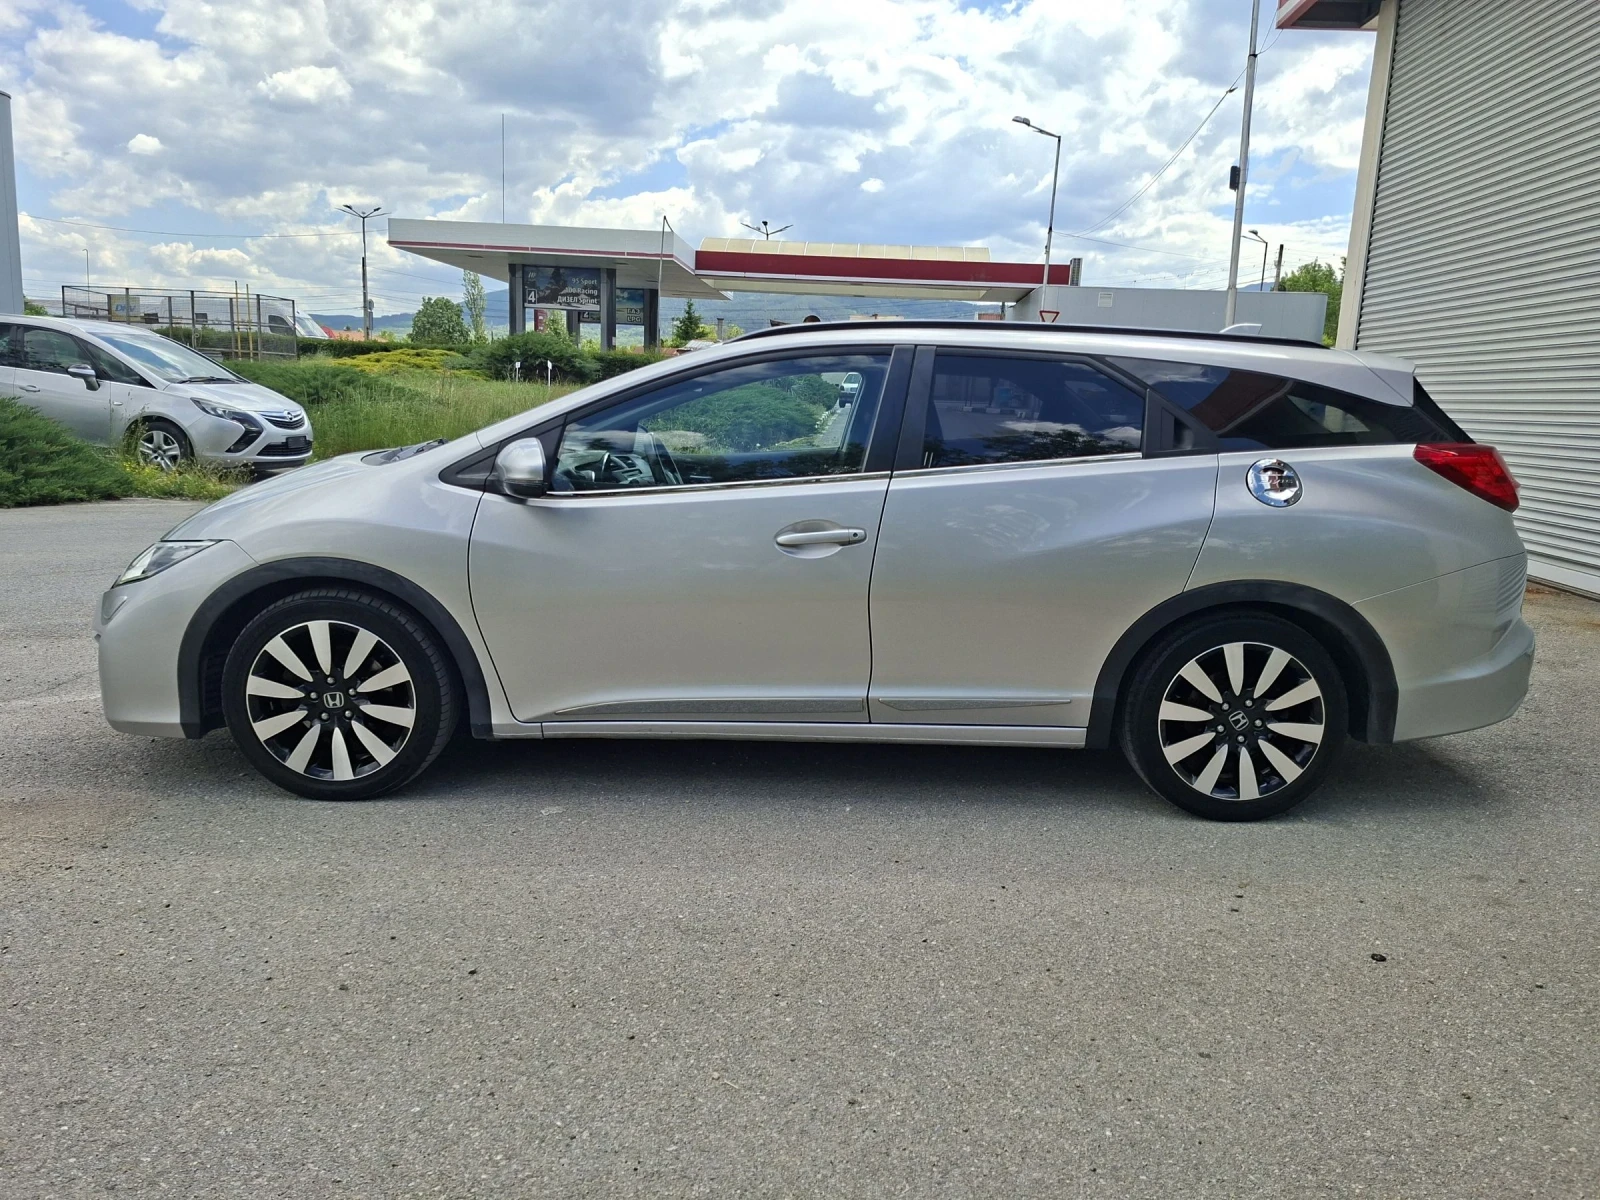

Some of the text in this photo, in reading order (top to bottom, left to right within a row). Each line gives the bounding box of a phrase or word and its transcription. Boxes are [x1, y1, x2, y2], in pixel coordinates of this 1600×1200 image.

[528, 291, 536, 303] 4
[577, 288, 598, 296] Racing
[557, 295, 598, 305] ДИЗЕЛ Sprint
